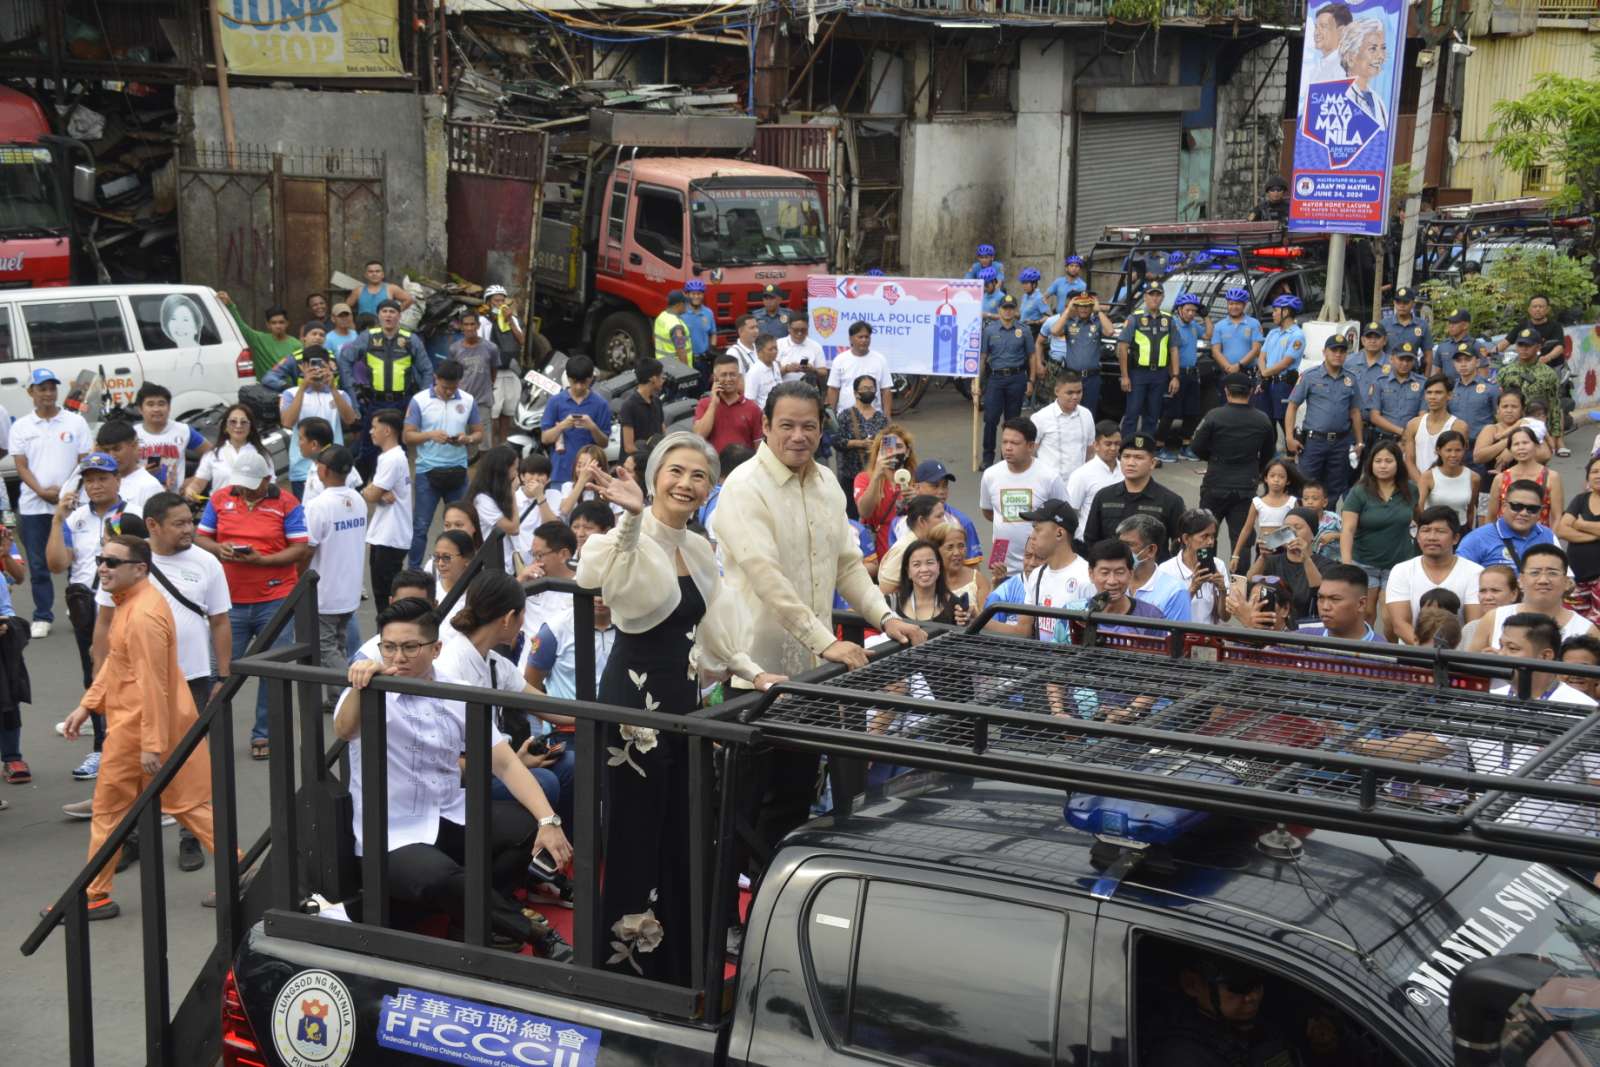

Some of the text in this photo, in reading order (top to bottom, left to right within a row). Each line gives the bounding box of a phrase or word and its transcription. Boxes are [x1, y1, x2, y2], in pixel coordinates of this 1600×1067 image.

[223, 0, 339, 33] JUNK
[1315, 115, 1353, 130] MAY
[1325, 130, 1364, 146] NILA
[755, 271, 785, 279] ISUZU
[841, 311, 932, 325] MANILA POLICE
[678, 379, 699, 390] POLICE
[1006, 496, 1028, 504] JONG
[333, 516, 366, 532] TANOD
[1407, 862, 1570, 1006] MANILA SWAT
[278, 975, 352, 1028] LUNGSOD NG MAYNILA
[388, 992, 589, 1051] 菲華商聯總會
[381, 1033, 412, 1047] Federation
[419, 1042, 438, 1055] Filipino
[439, 1046, 462, 1059] Chinese
[462, 1052, 493, 1066] Chambers
[493, 1057, 501, 1067] of
